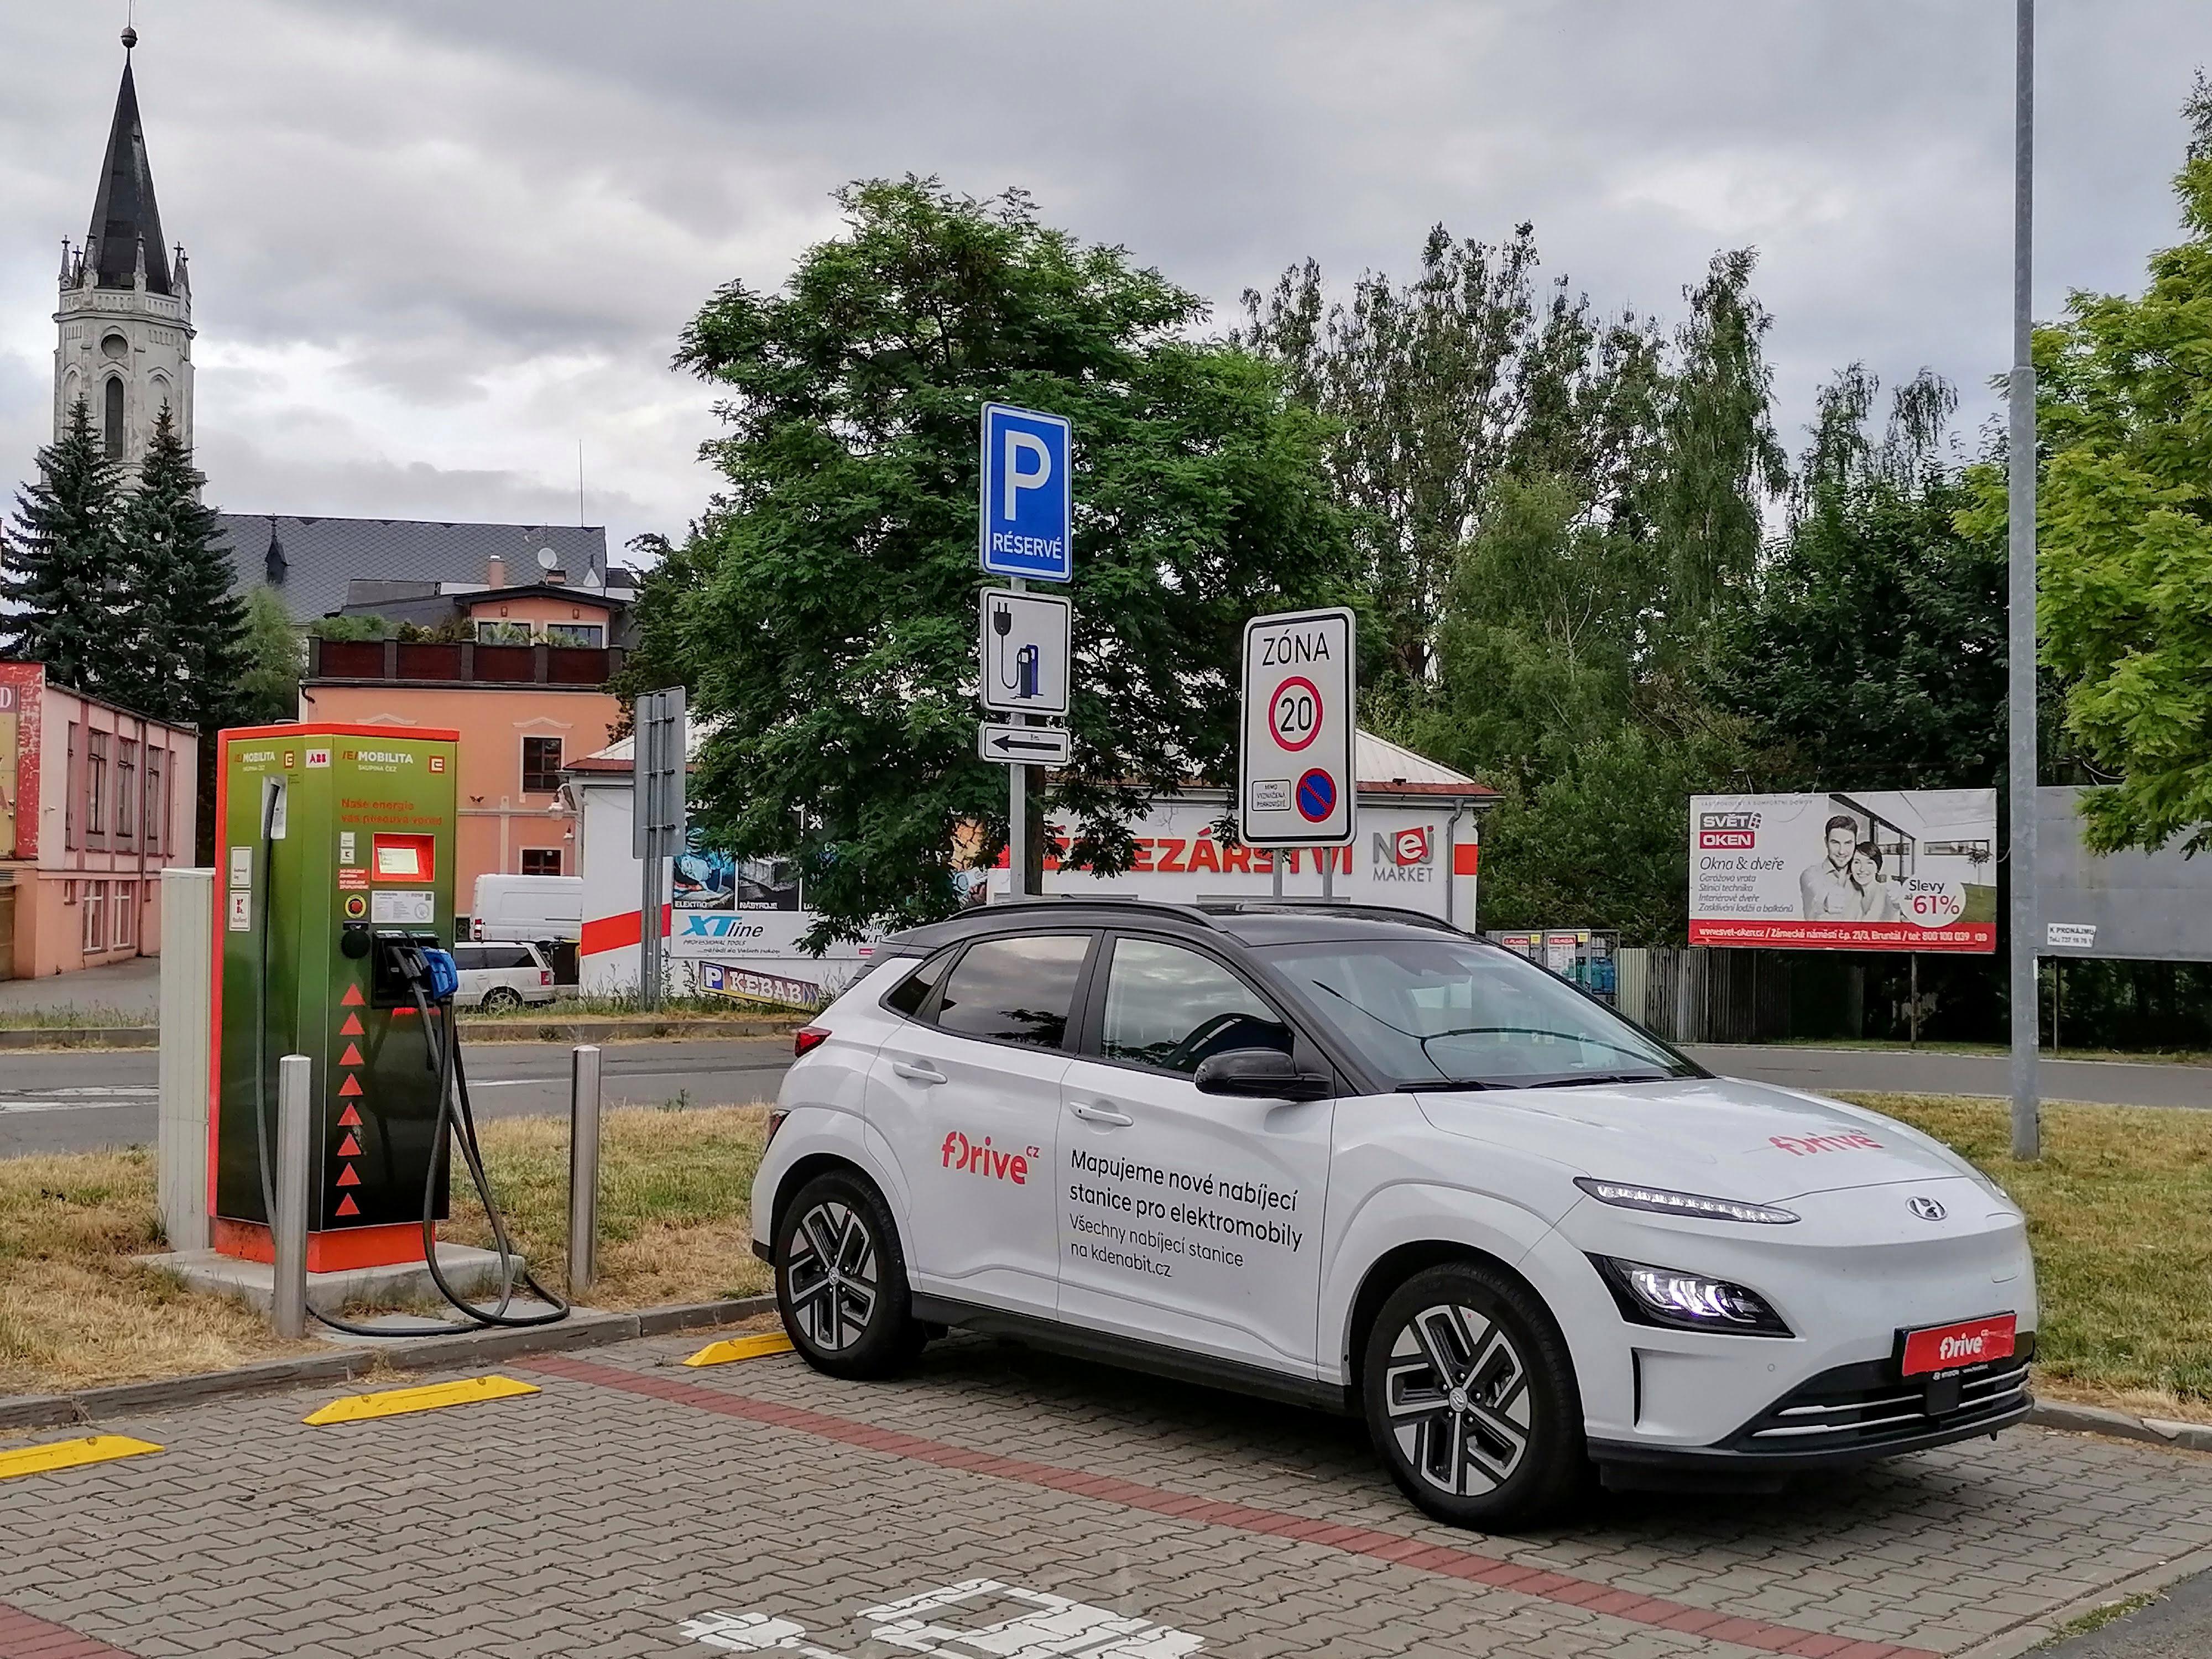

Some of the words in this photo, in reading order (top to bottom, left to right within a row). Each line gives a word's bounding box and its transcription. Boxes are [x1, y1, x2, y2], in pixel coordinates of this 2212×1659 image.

[1004, 429, 1052, 521] P
[993, 530, 1062, 560] RÉSERVÉ
[1262, 629, 1330, 666] ZÓNA
[1280, 696, 1312, 732] 20
[1703, 813, 1749, 827] SVĚT
[1703, 834, 1751, 846] OKEN
[1373, 867, 1434, 883] MARKET
[1700, 856, 1734, 870] Okna
[1736, 856, 1748, 870] &
[1750, 856, 1785, 870] dveře
[1909, 879, 1945, 894] Slevy
[1914, 895, 1960, 915] 61%
[680, 915, 764, 937] XTline
[705, 967, 722, 987] P
[729, 971, 802, 1003] KEBAB
[1071, 1148, 1164, 1186] Mapujeme
[1168, 1173, 1214, 1195] nové
[1219, 1181, 1298, 1212] nabíjecí
[1070, 1183, 1132, 1212] stanice
[1136, 1199, 1166, 1219] pro
[1170, 1203, 1303, 1253] elektromobily
[1069, 1213, 1126, 1245] Všechny
[1129, 1229, 1186, 1254] nabíjecí
[1188, 1242, 1244, 1267] stanice
[1071, 1242, 1088, 1258] na
[1091, 1244, 1172, 1277] kdenabit.cz
